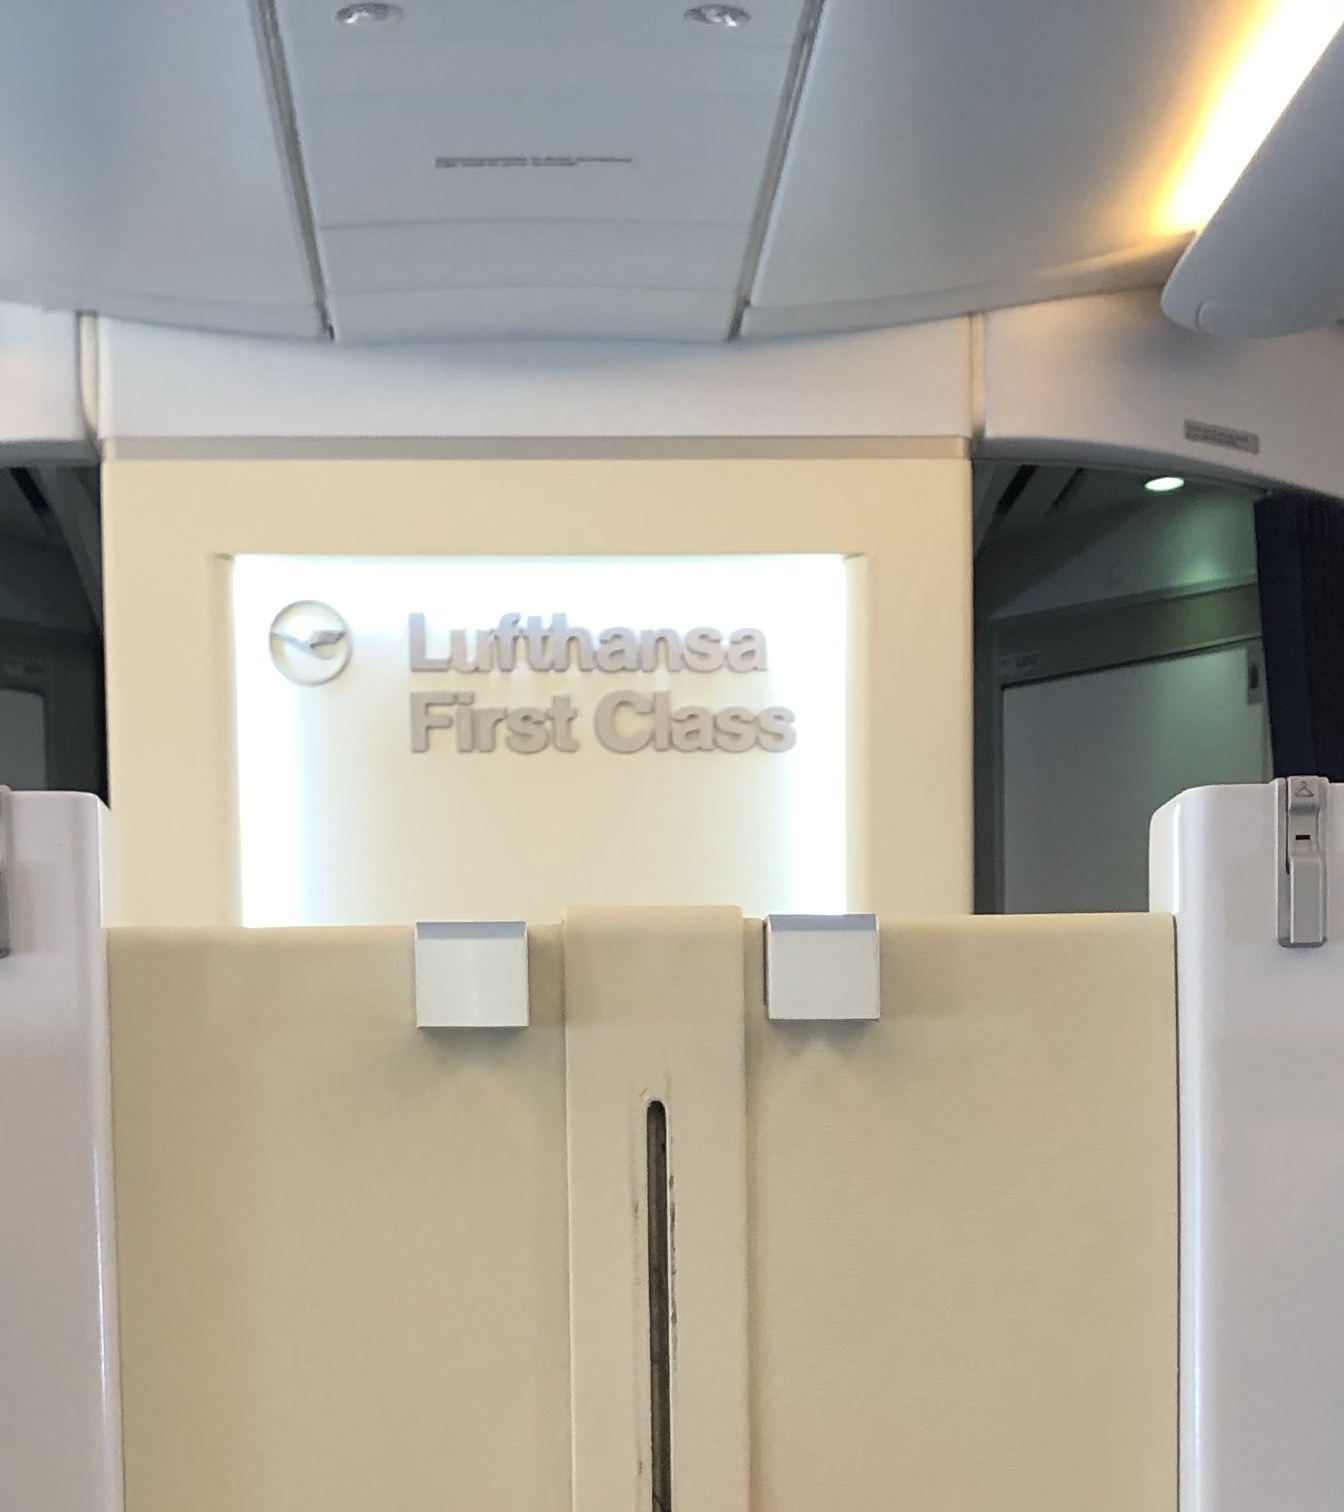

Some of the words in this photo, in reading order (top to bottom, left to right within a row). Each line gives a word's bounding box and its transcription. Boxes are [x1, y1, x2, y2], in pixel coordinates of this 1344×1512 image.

[408, 612, 769, 674] Lufthansa
[410, 691, 579, 754] First
[593, 690, 797, 754] Class
